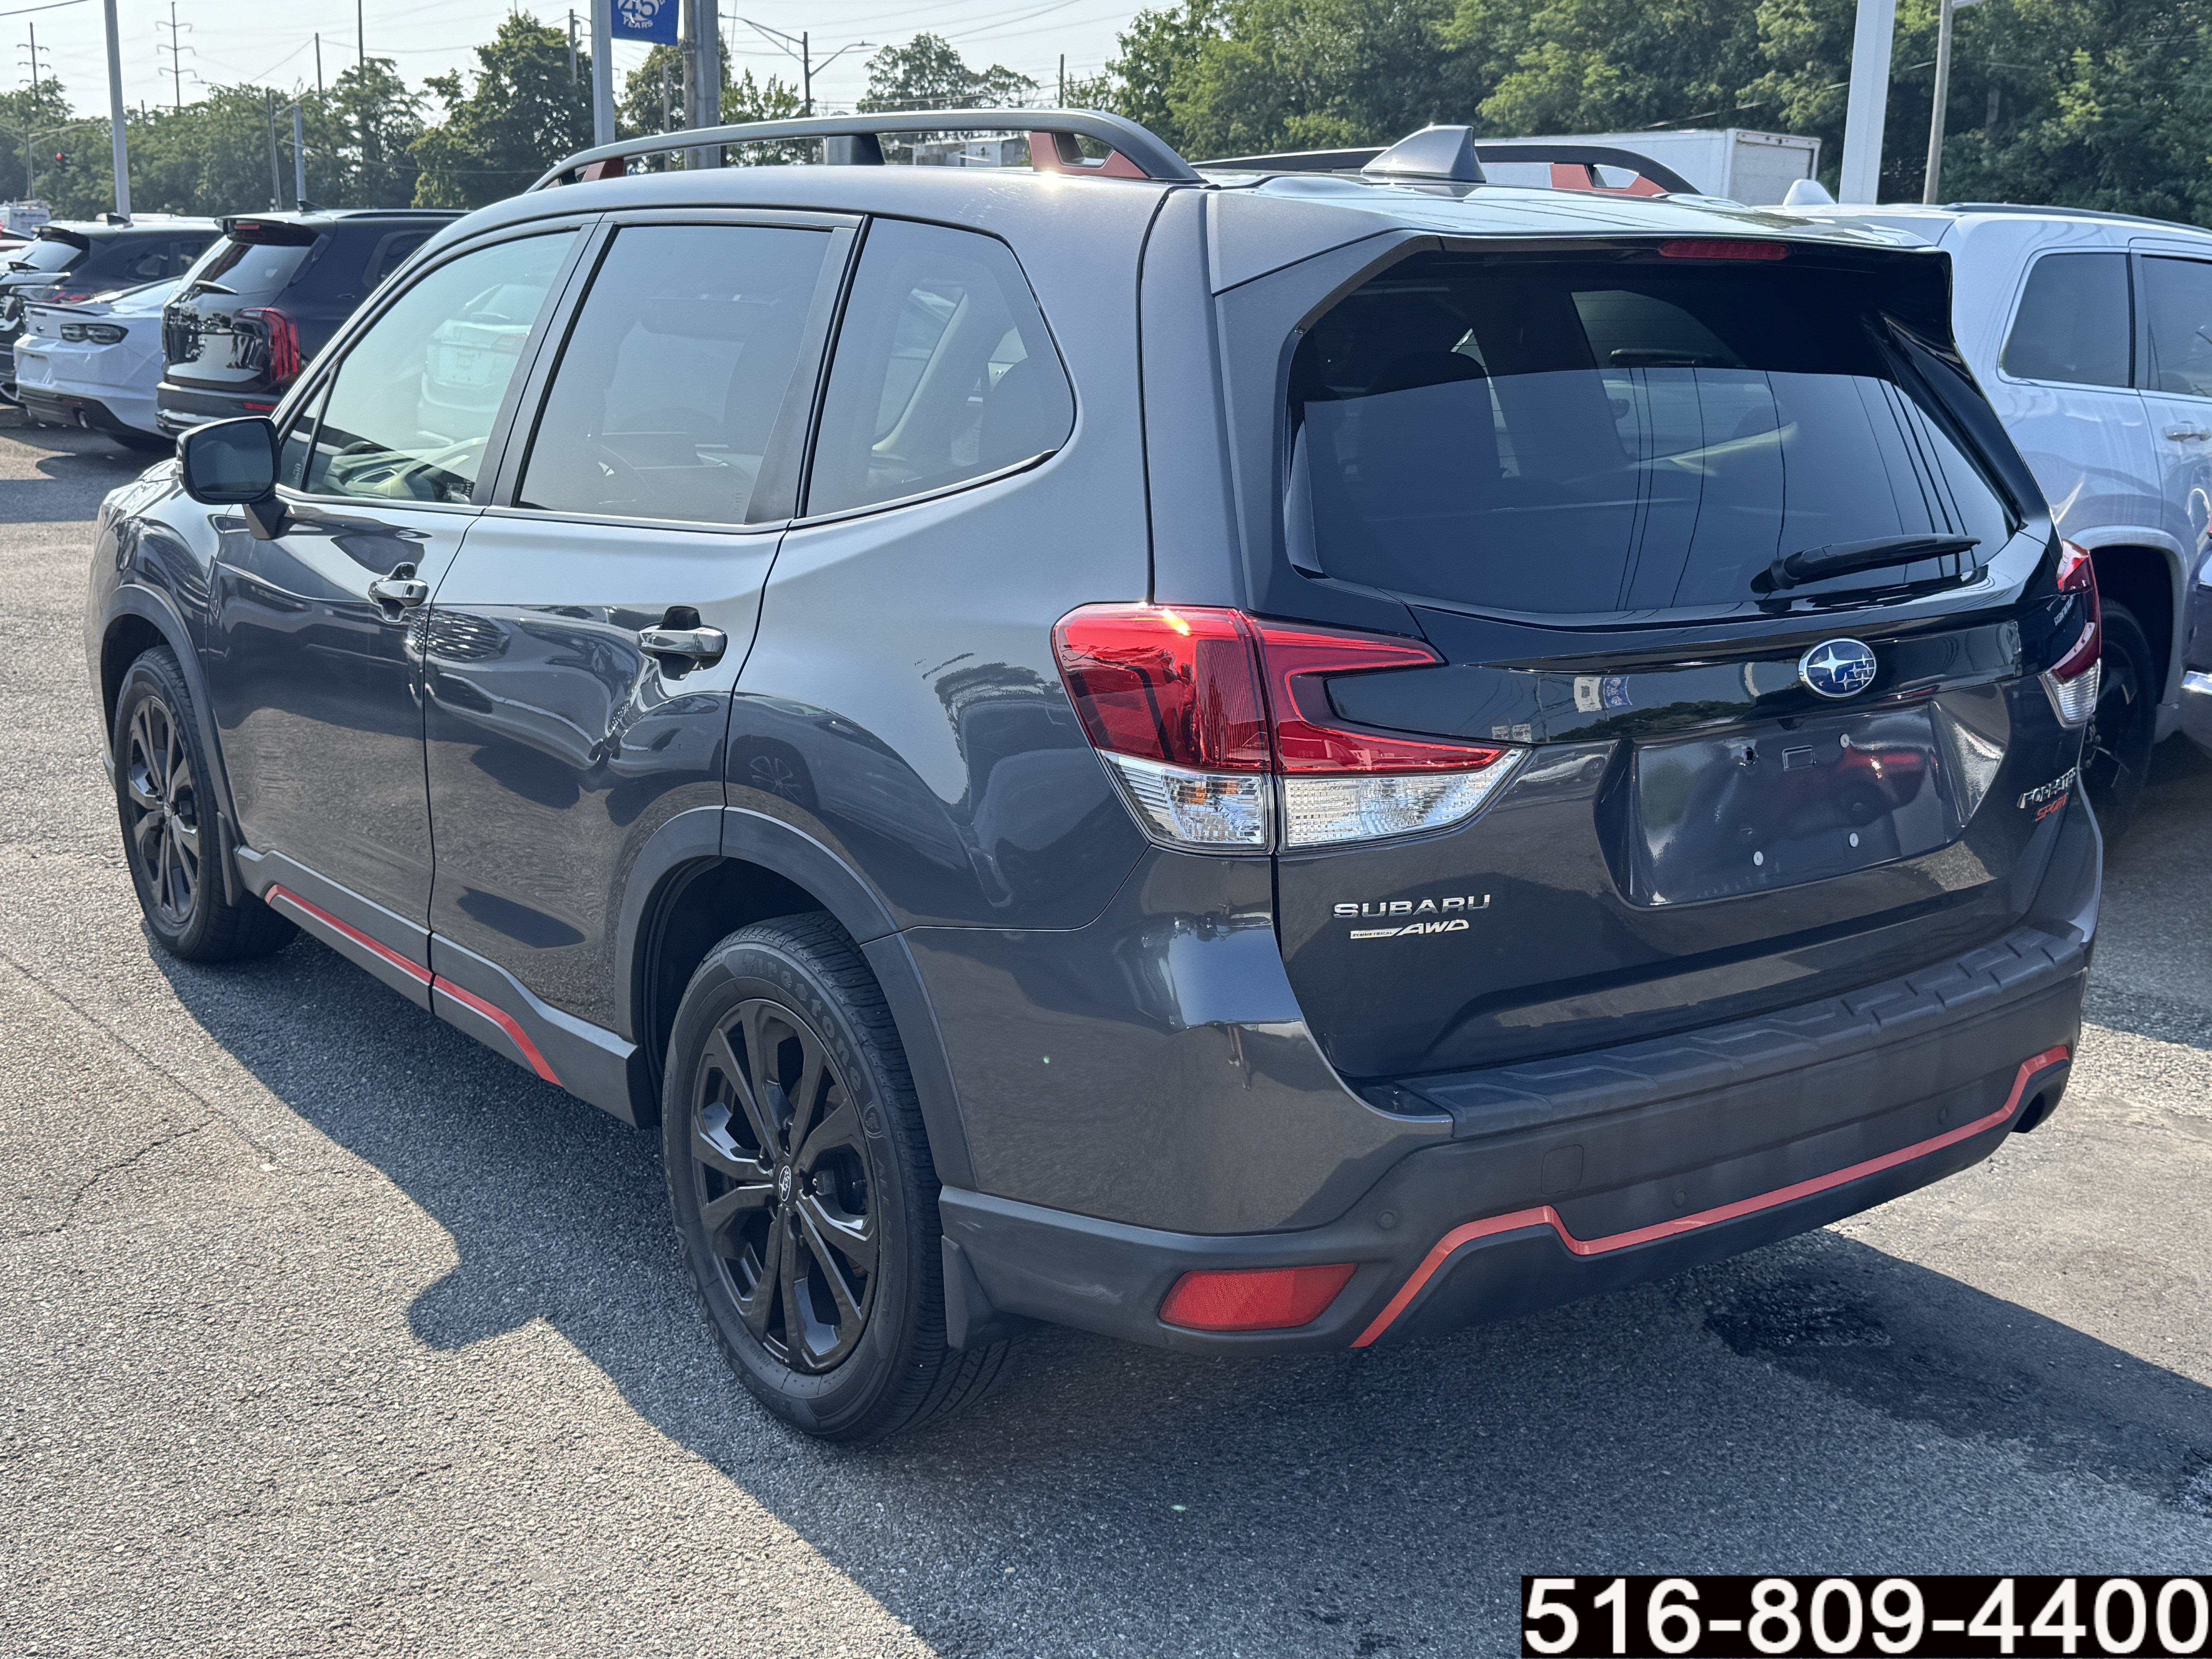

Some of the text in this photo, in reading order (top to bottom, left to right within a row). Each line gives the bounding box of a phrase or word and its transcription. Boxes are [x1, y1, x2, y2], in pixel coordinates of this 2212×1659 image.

[623, 17, 654, 29] YEARS
[1333, 894, 1490, 918] SUBARU
[1396, 919, 1469, 936] AWD
